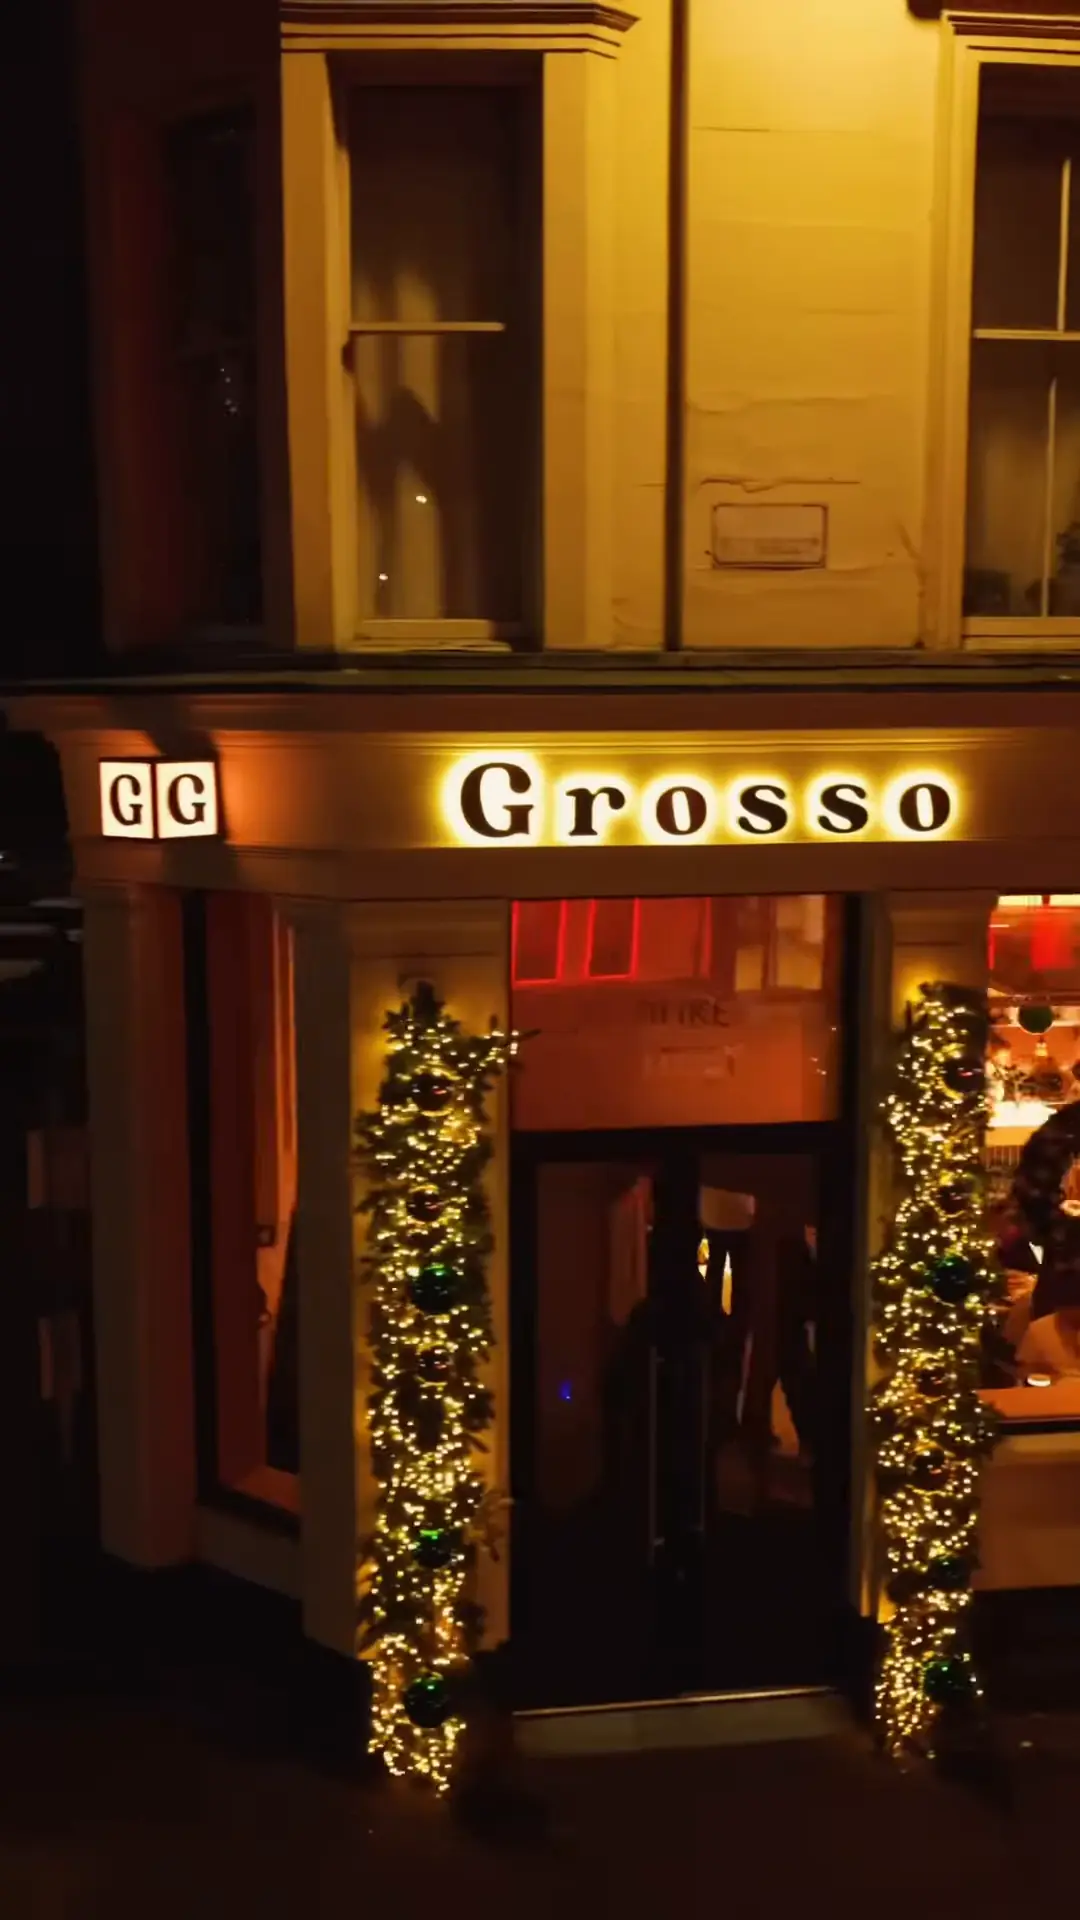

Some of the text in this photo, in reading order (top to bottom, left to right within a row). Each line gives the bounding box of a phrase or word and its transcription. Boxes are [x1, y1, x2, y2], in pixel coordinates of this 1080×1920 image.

[110, 774, 143, 825] G
[168, 774, 206, 825] G
[461, 762, 951, 837] Grosso
